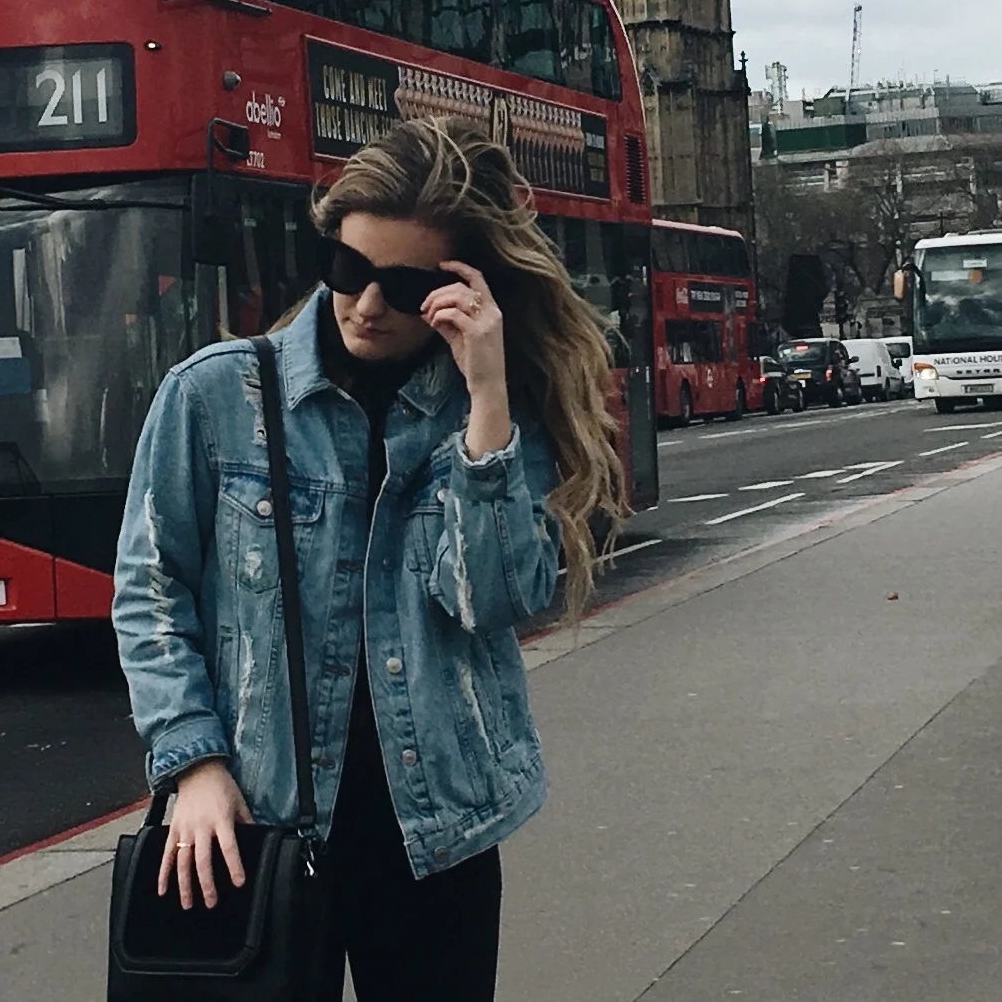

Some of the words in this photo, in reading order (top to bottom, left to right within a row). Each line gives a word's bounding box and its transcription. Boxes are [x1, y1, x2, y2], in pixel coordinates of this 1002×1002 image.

[35, 67, 108, 127] 211
[245, 90, 282, 128] abellio
[934, 356, 978, 366] NATIONAL
